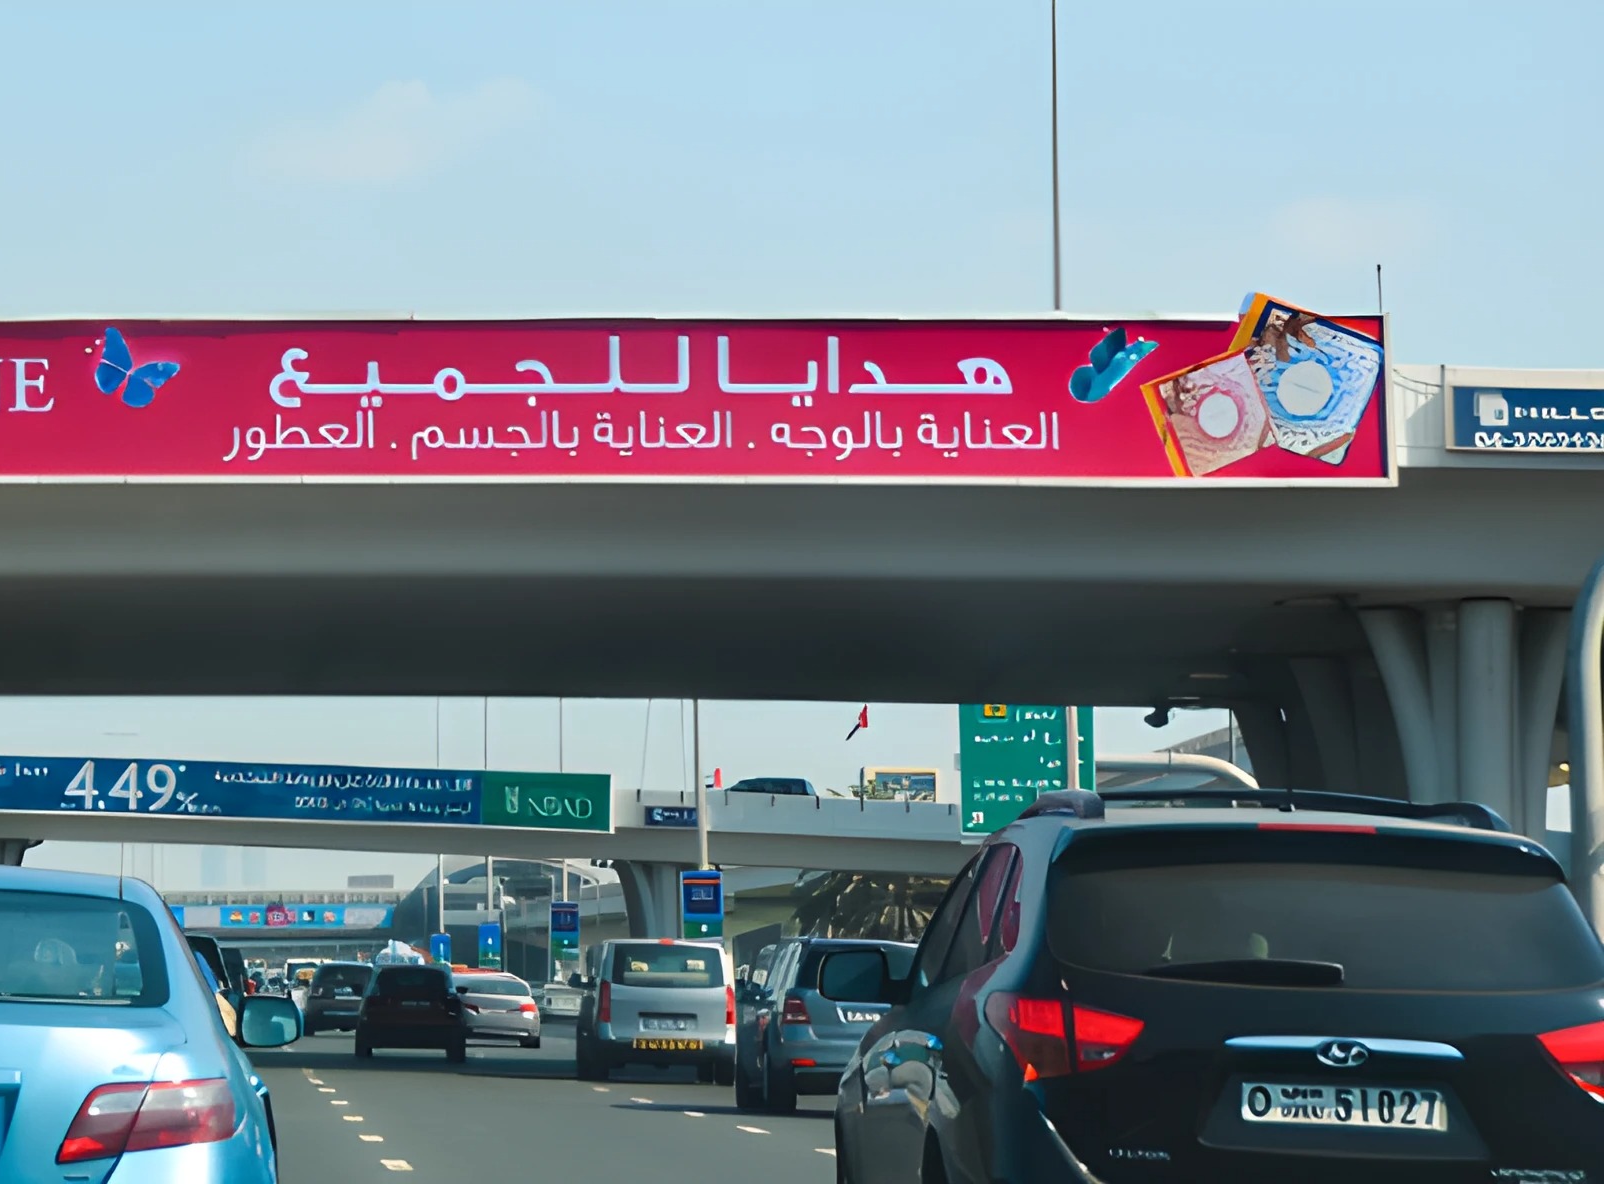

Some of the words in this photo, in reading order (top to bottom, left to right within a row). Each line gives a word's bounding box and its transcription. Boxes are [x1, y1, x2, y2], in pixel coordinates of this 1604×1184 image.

[269, 335, 689, 408] للجميع
[717, 336, 1013, 407] هدايا
[222, 409, 375, 461] العطور
[411, 410, 580, 460] بالجسم
[593, 410, 732, 457] العناية
[770, 411, 904, 461] بالوجه
[916, 411, 1060, 458] العناية
